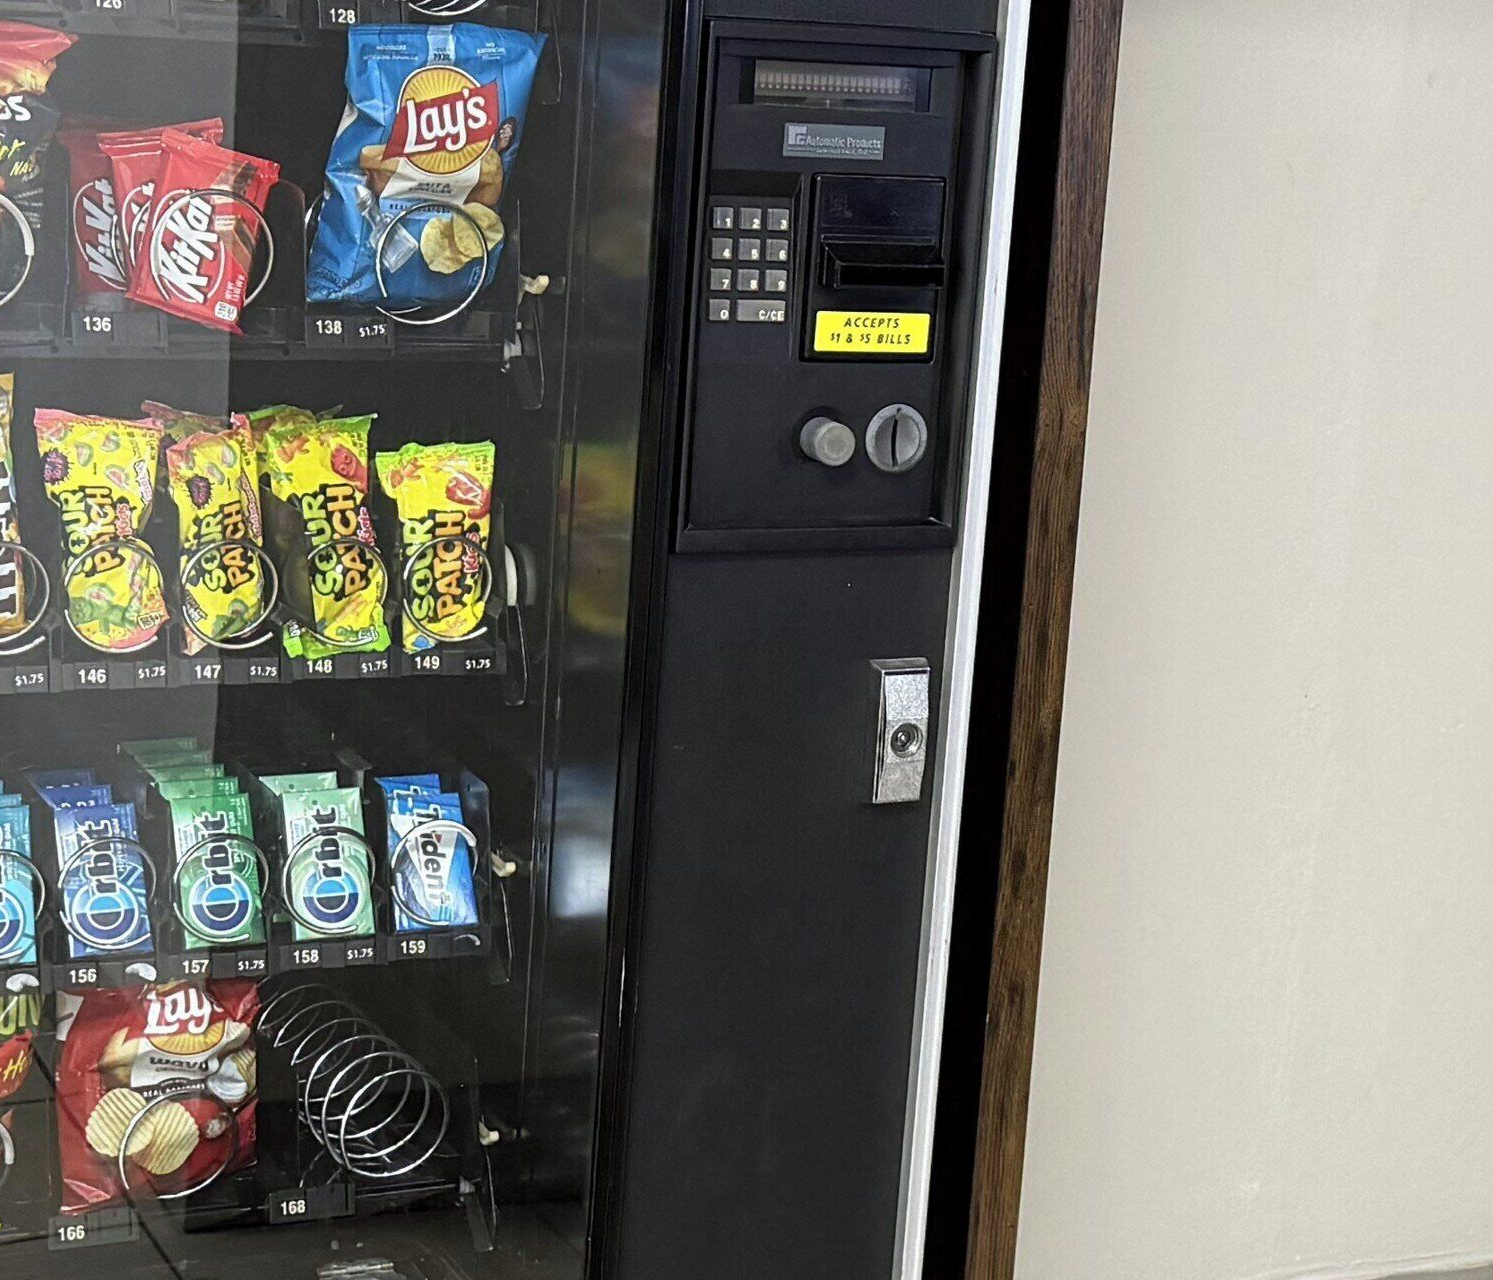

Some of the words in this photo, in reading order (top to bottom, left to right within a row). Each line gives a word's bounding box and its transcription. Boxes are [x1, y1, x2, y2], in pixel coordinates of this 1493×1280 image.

[328, 8, 356, 24] 128
[403, 87, 488, 154] Lay's
[724, 218, 731, 228] 1
[752, 219, 761, 229] 2
[780, 220, 788, 229] 3
[722, 248, 731, 258] 4
[750, 249, 758, 259] 5
[778, 249, 787, 260] 6
[721, 280, 730, 290] 7
[749, 280, 757, 290] 8
[777, 280, 786, 290] 9
[720, 310, 729, 320] 0
[82, 316, 112, 332] 136
[315, 320, 343, 335] 138
[358, 323, 386, 338] $1.75
[843, 316, 900, 330] ACCEPTS
[830, 332, 841, 344] $1
[859, 333, 872, 344] $5
[877, 333, 912, 346] BILLS
[222, 501, 252, 592] PATCH
[301, 492, 344, 595] SOUR
[326, 482, 370, 597] PATCH
[402, 517, 436, 621] SOUR
[433, 511, 468, 620] PATCH
[305, 659, 333, 674] 148
[361, 659, 388, 673] $1.75
[414, 655, 440, 670] 149
[465, 658, 491, 670] $1.75
[77, 668, 107, 684] 146
[137, 665, 166, 679] $1.75
[194, 664, 222, 680] 147
[249, 665, 278, 677] $1.75
[14, 673, 45, 687] $1.75
[412, 804, 452, 904] Tident
[400, 940, 426, 954] 159
[293, 949, 319, 963] 158
[347, 947, 373, 960] $1.75
[182, 959, 209, 974] 157
[237, 960, 265, 971] $1.75
[68, 968, 97, 984] 156
[280, 1200, 306, 1216] 168
[57, 1225, 85, 1241] 166
